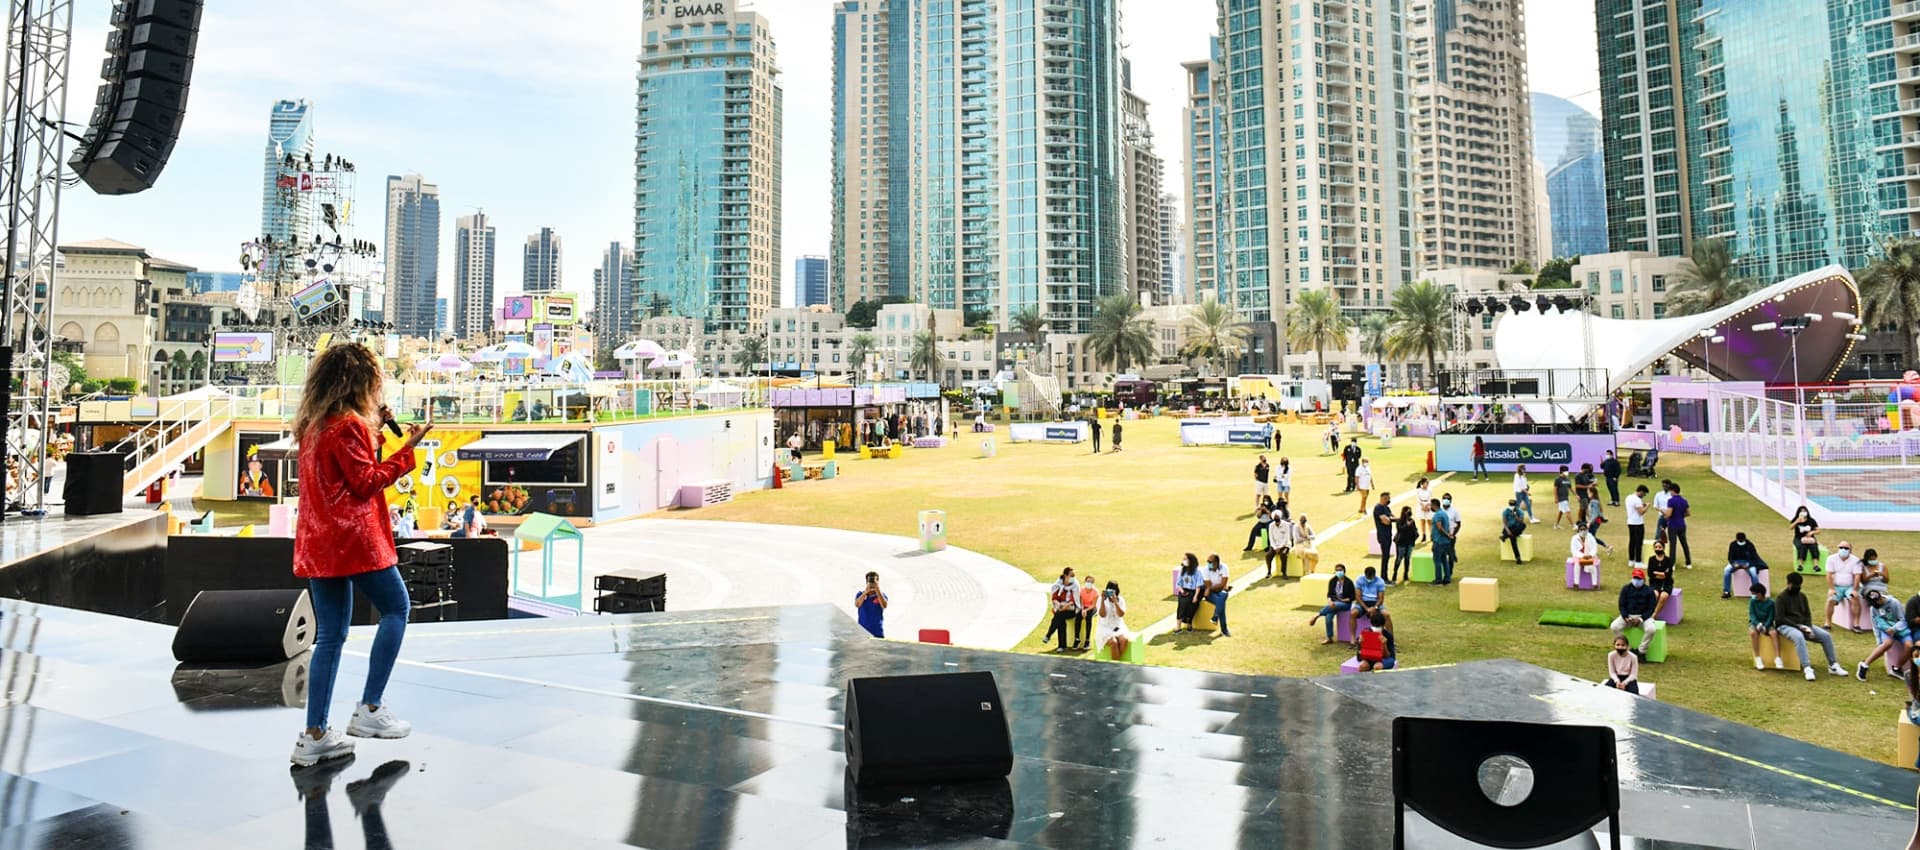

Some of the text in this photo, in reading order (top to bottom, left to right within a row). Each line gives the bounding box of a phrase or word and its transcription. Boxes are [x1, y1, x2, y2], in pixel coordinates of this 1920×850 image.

[675, 2, 724, 18] EMAAR
[1484, 449, 1520, 459] etisalat
[1533, 449, 1567, 459] اتصالات
